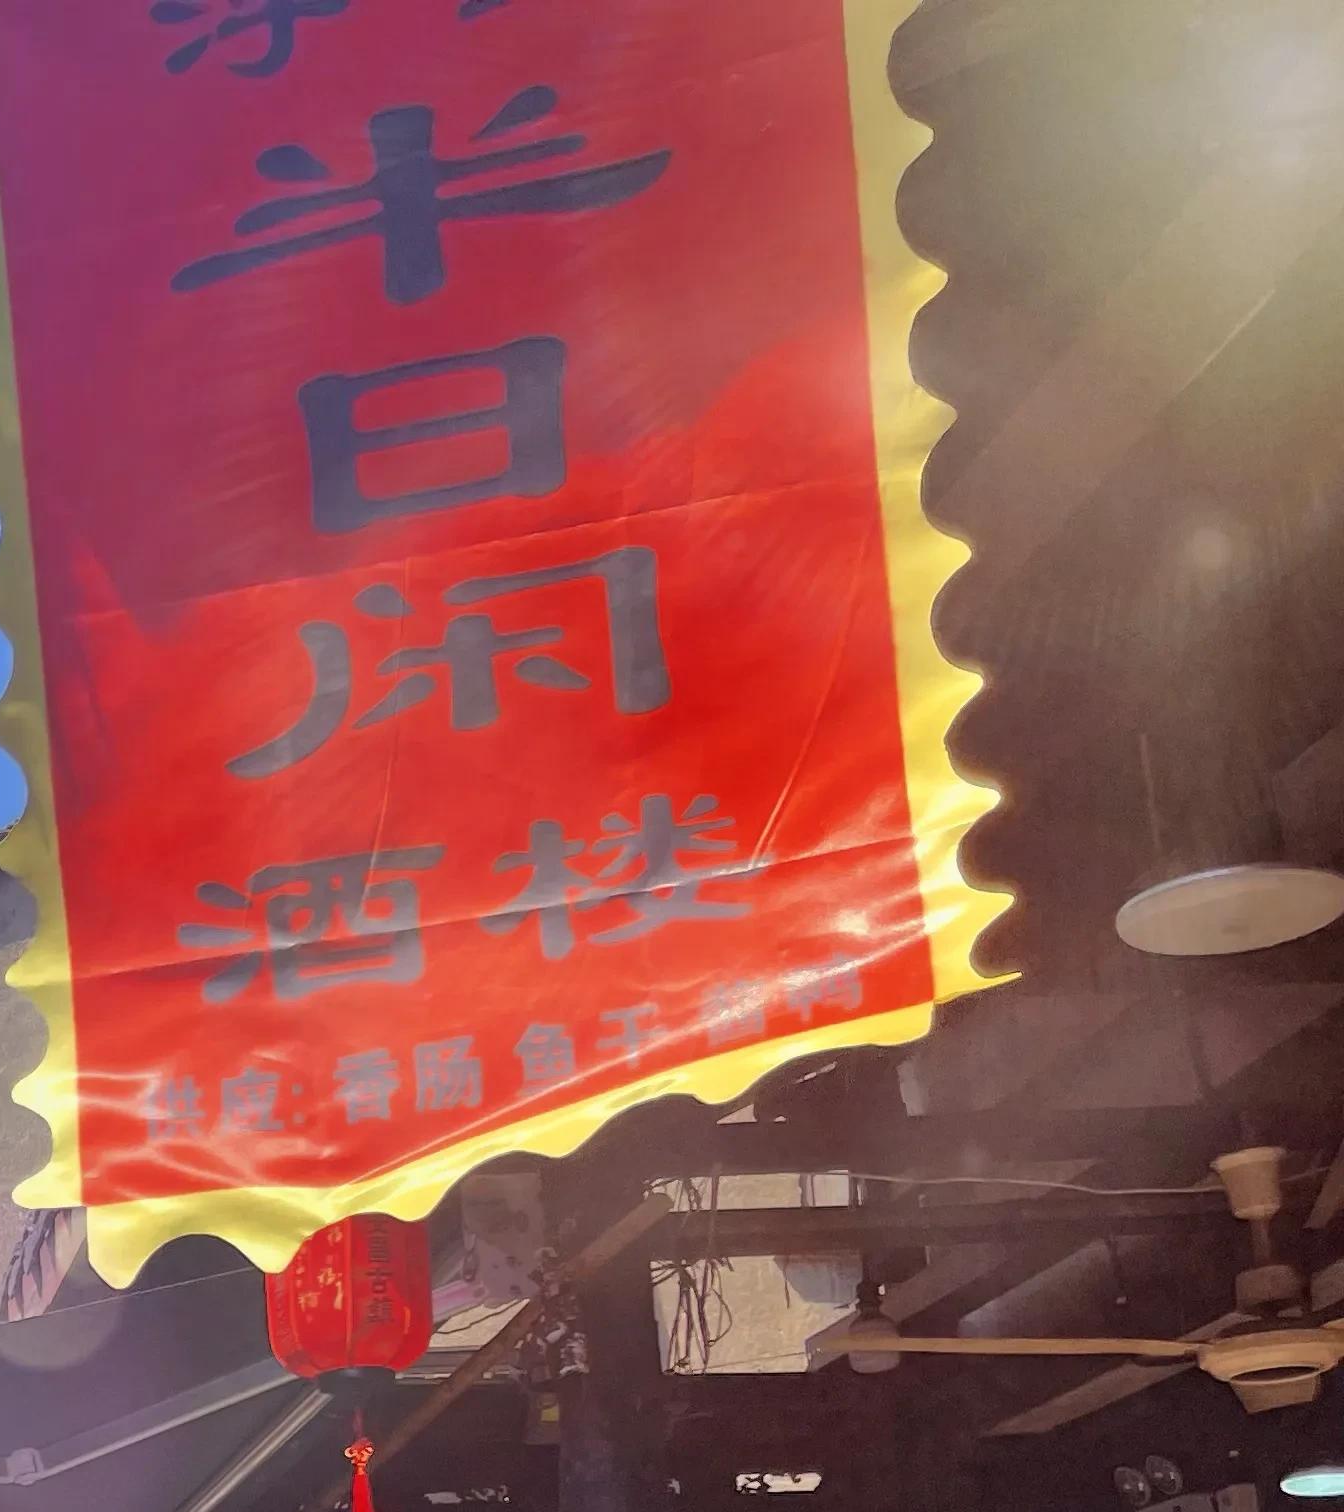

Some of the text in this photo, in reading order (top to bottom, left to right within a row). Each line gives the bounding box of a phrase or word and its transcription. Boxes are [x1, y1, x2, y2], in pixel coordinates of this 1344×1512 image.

[178, 793, 774, 1004] 酒楼
[332, 1035, 484, 1124] 香肠
[515, 1002, 666, 1097] 鱼干
